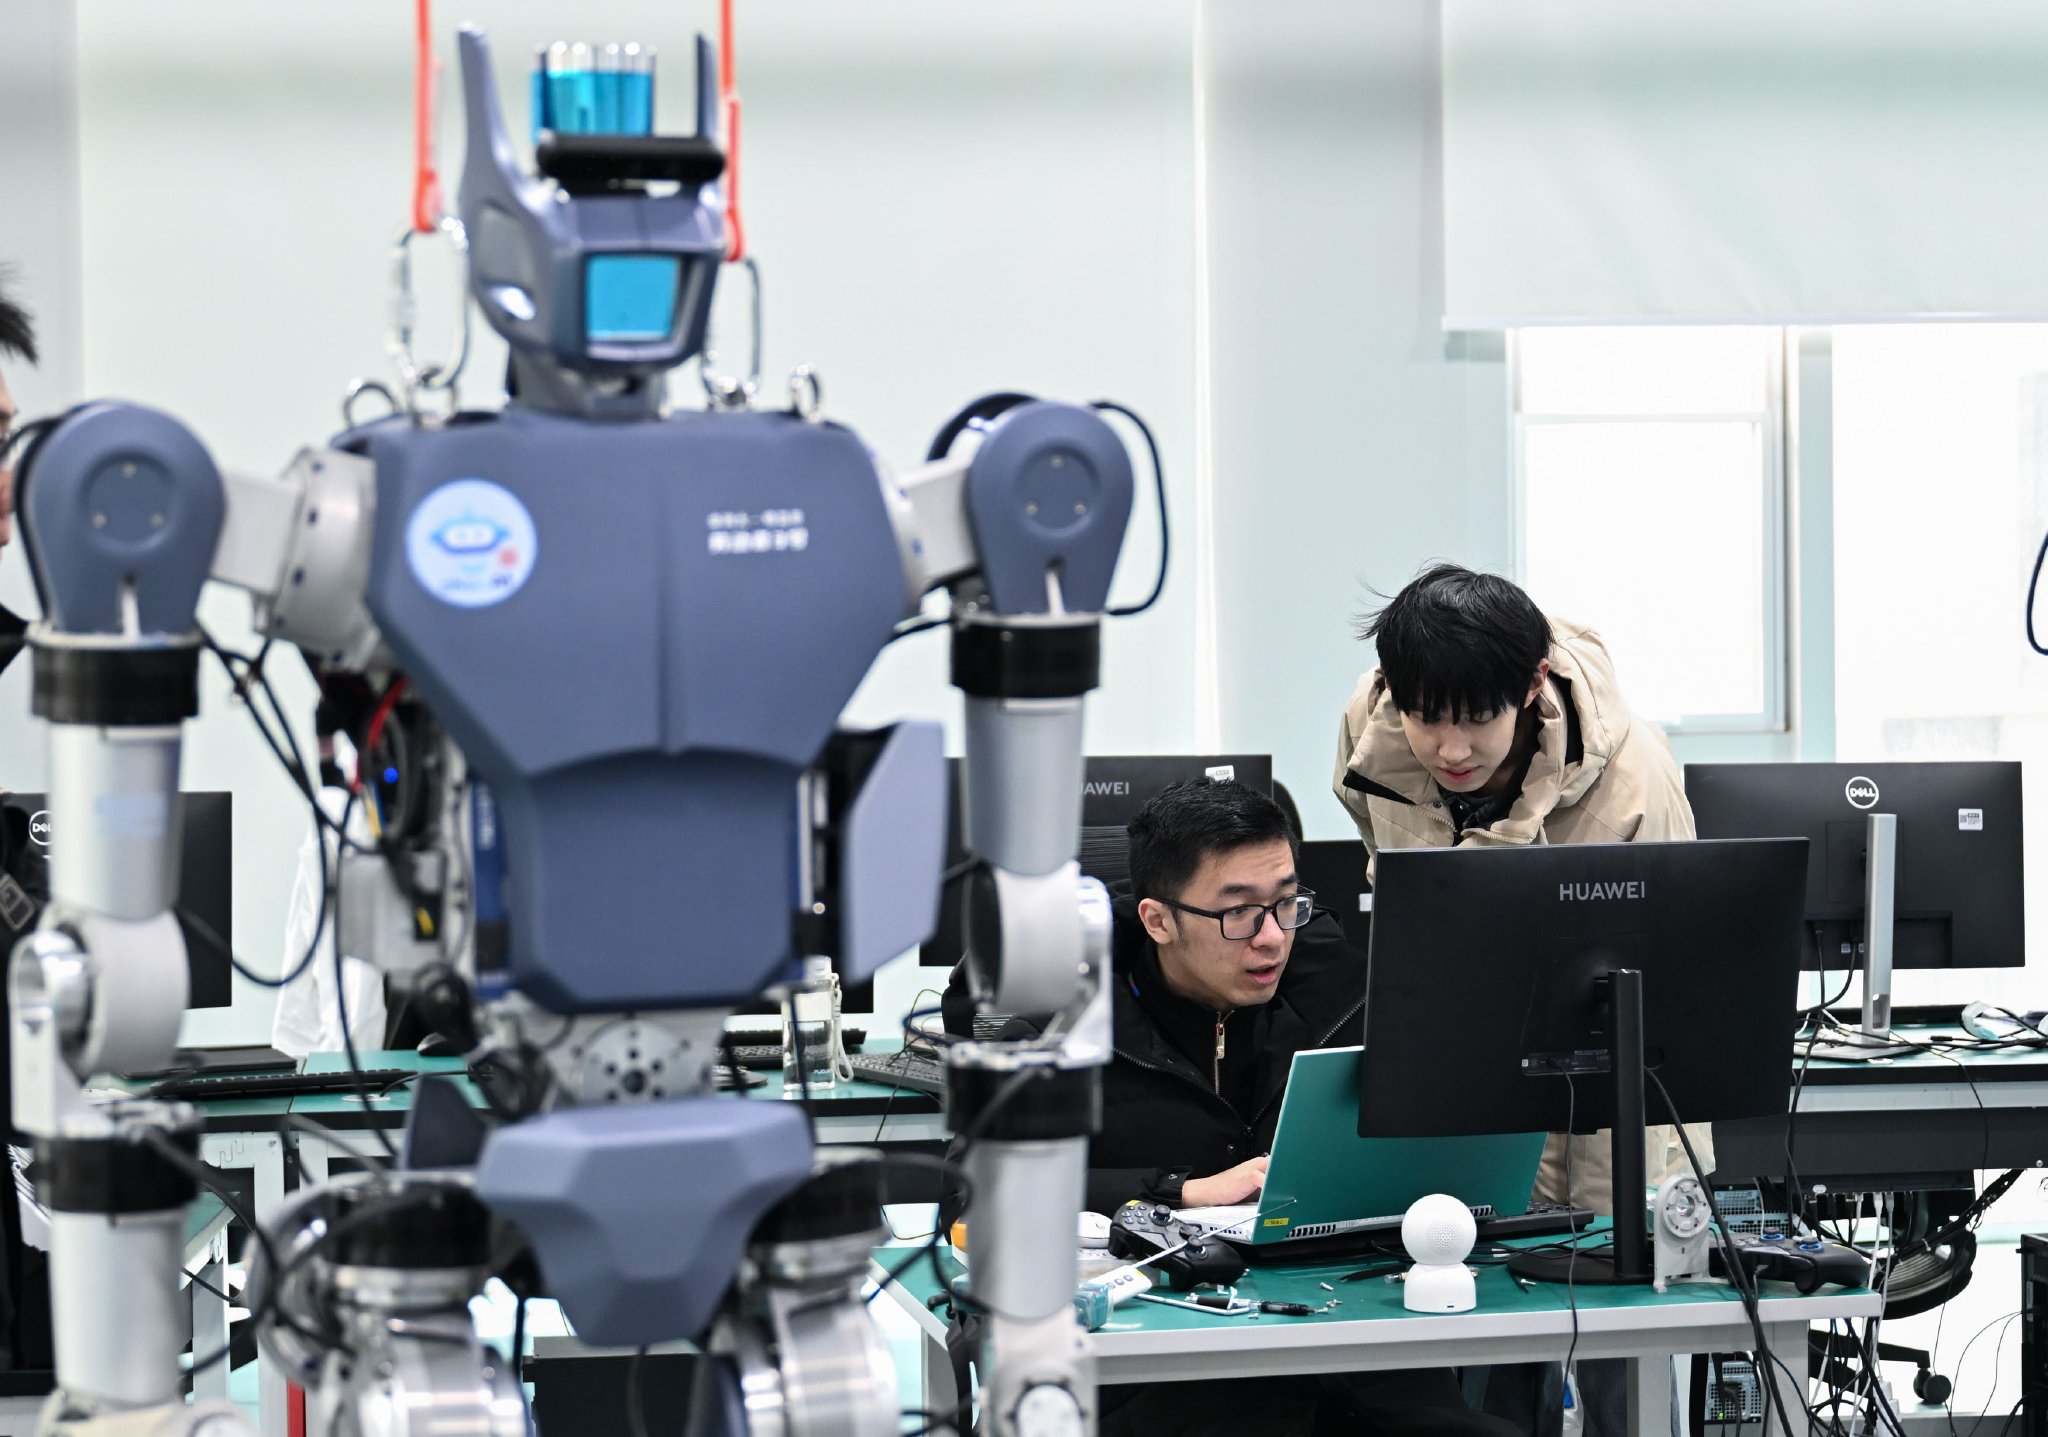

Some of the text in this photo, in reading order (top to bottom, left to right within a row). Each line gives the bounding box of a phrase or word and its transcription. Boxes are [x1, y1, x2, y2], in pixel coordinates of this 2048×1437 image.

[1081, 781, 1130, 796] AWEI
[1850, 787, 1876, 798] DELL
[1559, 881, 1645, 901] HUAWEI
